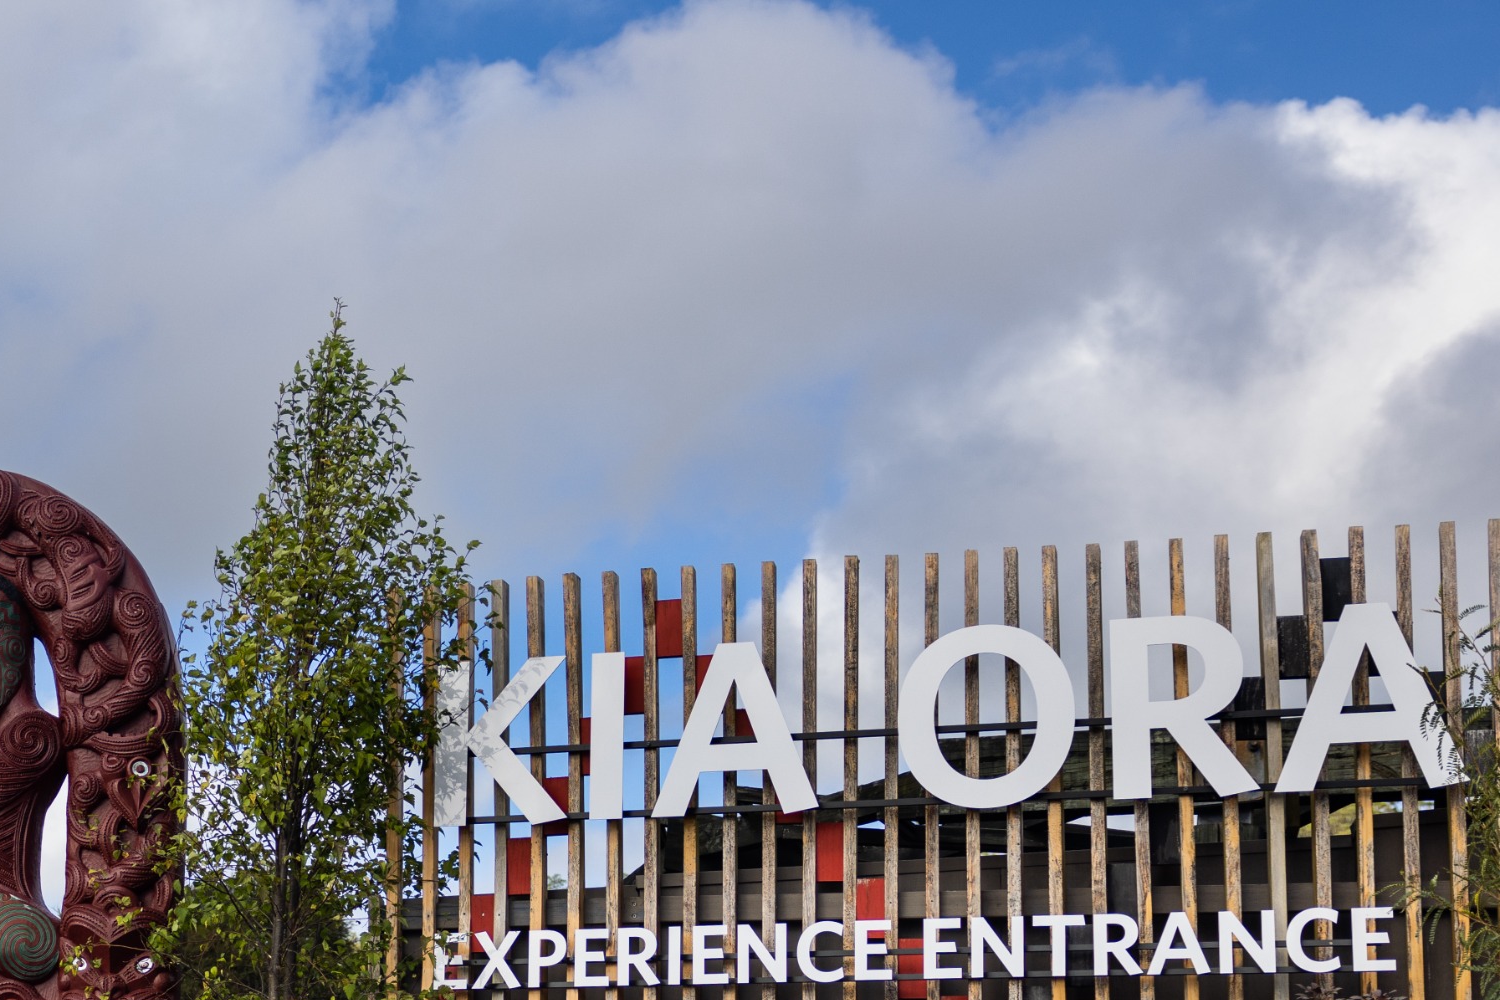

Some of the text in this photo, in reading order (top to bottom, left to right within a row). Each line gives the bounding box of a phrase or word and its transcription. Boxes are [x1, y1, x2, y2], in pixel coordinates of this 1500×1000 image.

[434, 603, 1469, 826] KIA ORA
[433, 907, 1397, 990] EXPERIENCE ENTRANCE
